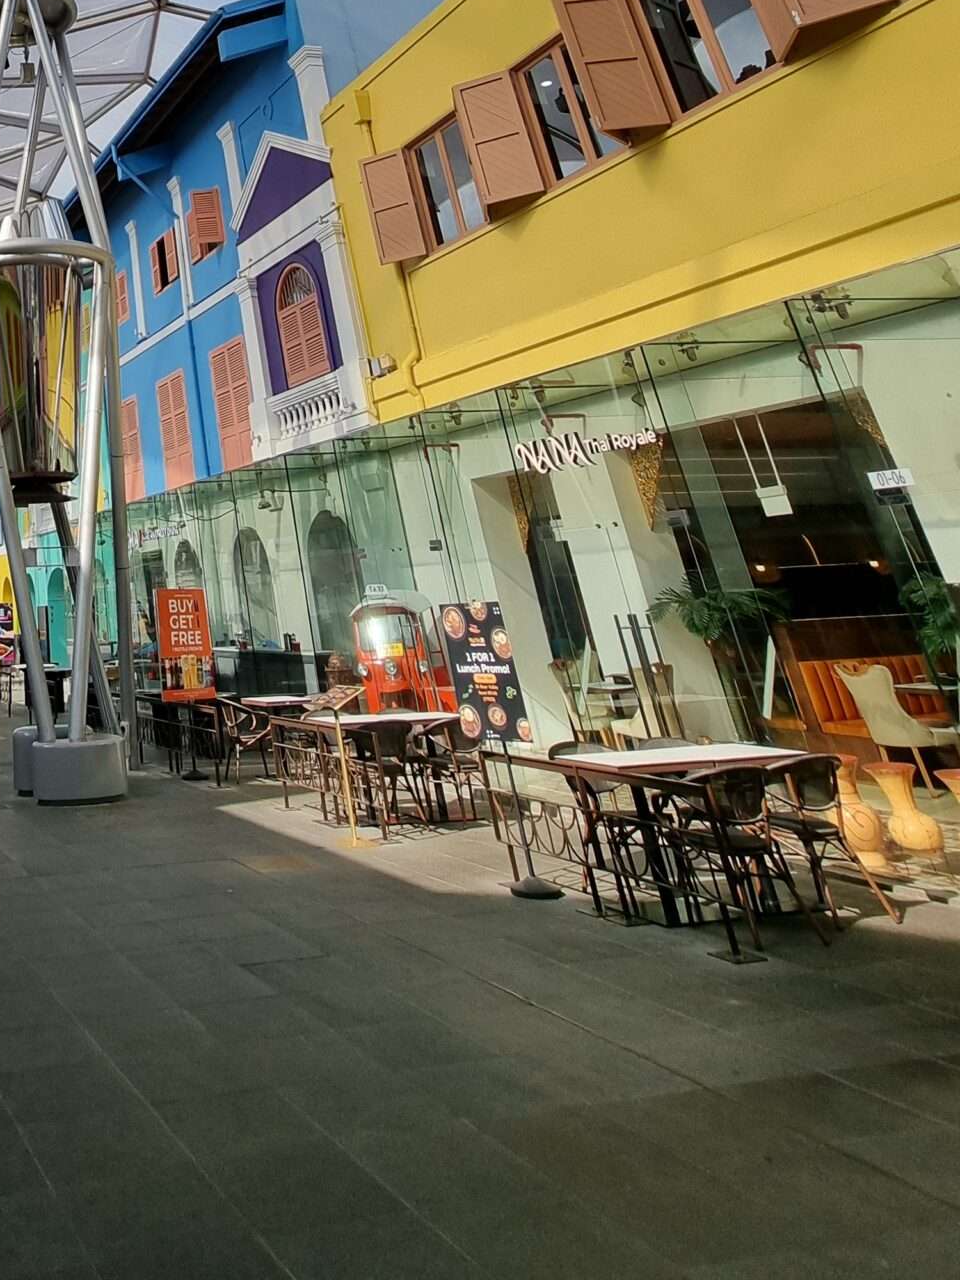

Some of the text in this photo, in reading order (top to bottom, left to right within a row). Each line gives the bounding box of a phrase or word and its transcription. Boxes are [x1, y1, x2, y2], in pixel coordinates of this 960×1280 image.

[583, 437, 610, 454] Thai
[611, 428, 657, 451] Royale
[876, 470, 907, 487] 01-06
[168, 599, 194, 613] BUY
[169, 615, 194, 629] GET
[171, 631, 202, 646] FREE
[465, 652, 496, 663] 1 FOR 1
[456, 664, 511, 674] Lunch Promo!
